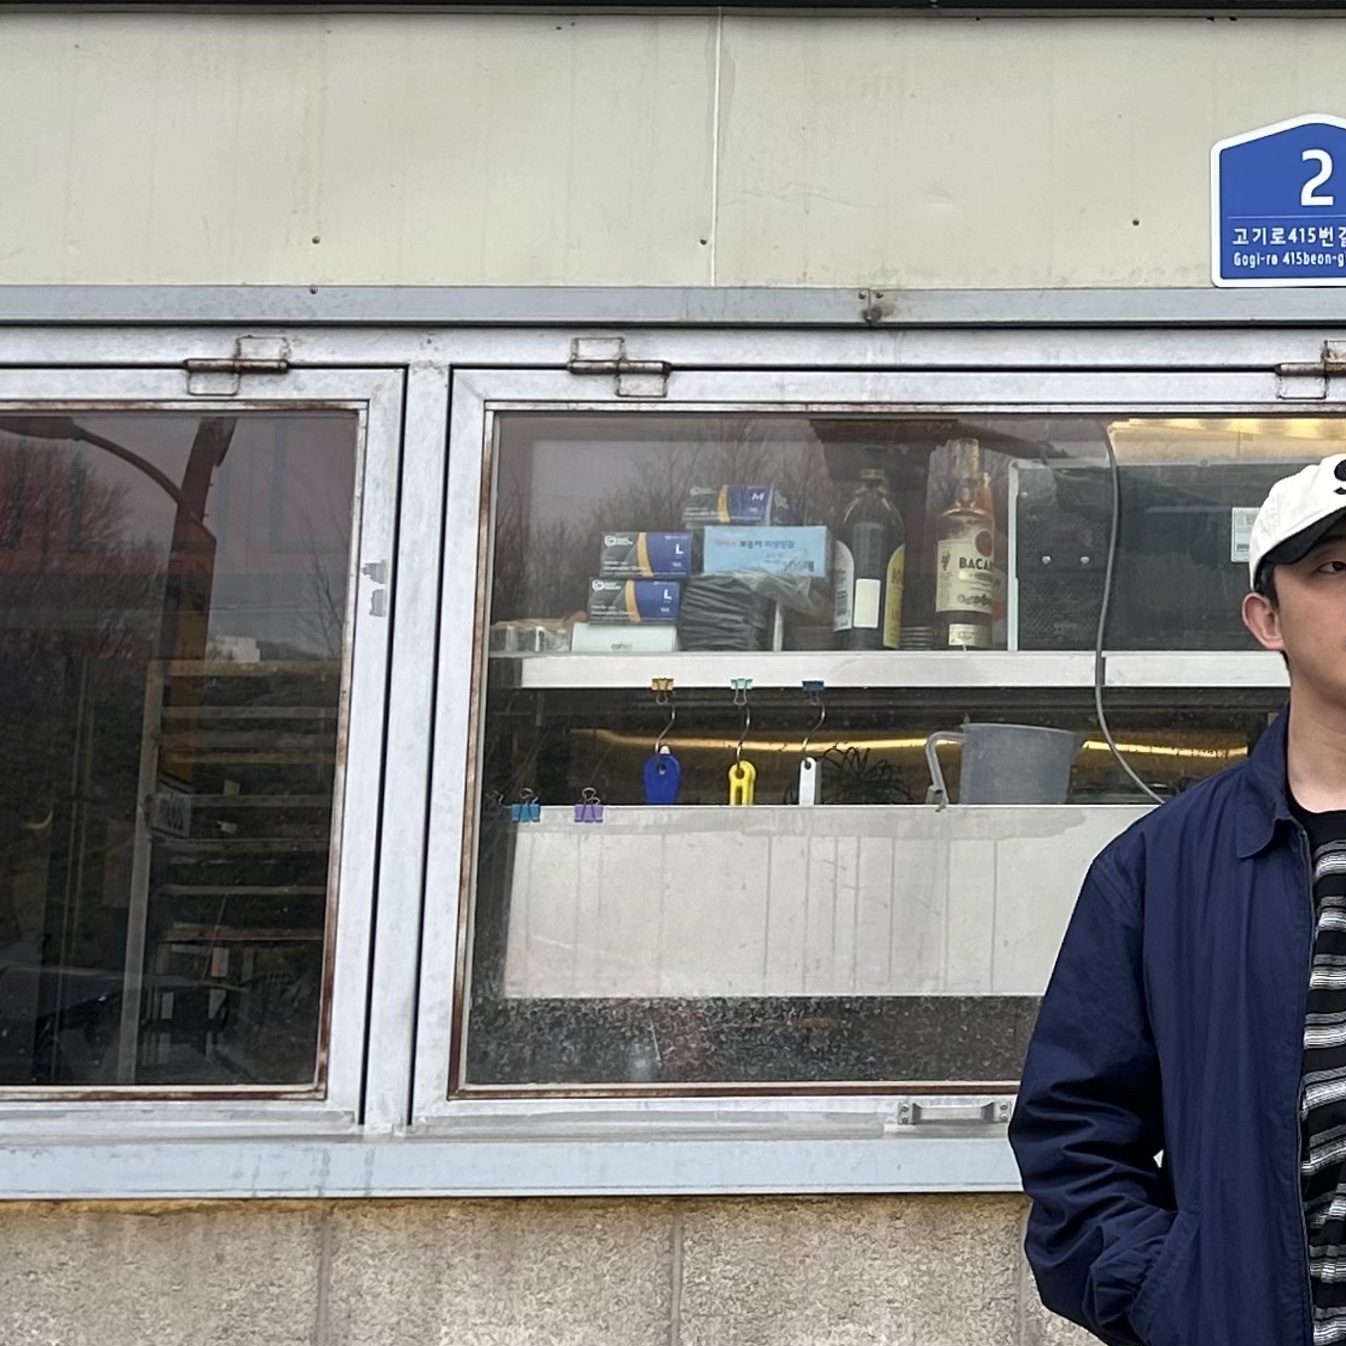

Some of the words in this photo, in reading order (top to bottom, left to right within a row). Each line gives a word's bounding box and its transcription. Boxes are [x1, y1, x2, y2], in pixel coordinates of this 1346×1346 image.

[1301, 149, 1334, 206] 2
[1233, 252, 1278, 269] Gogi-ro
[751, 492, 765, 501] M
[675, 543, 684, 555] L
[663, 588, 673, 600] L
